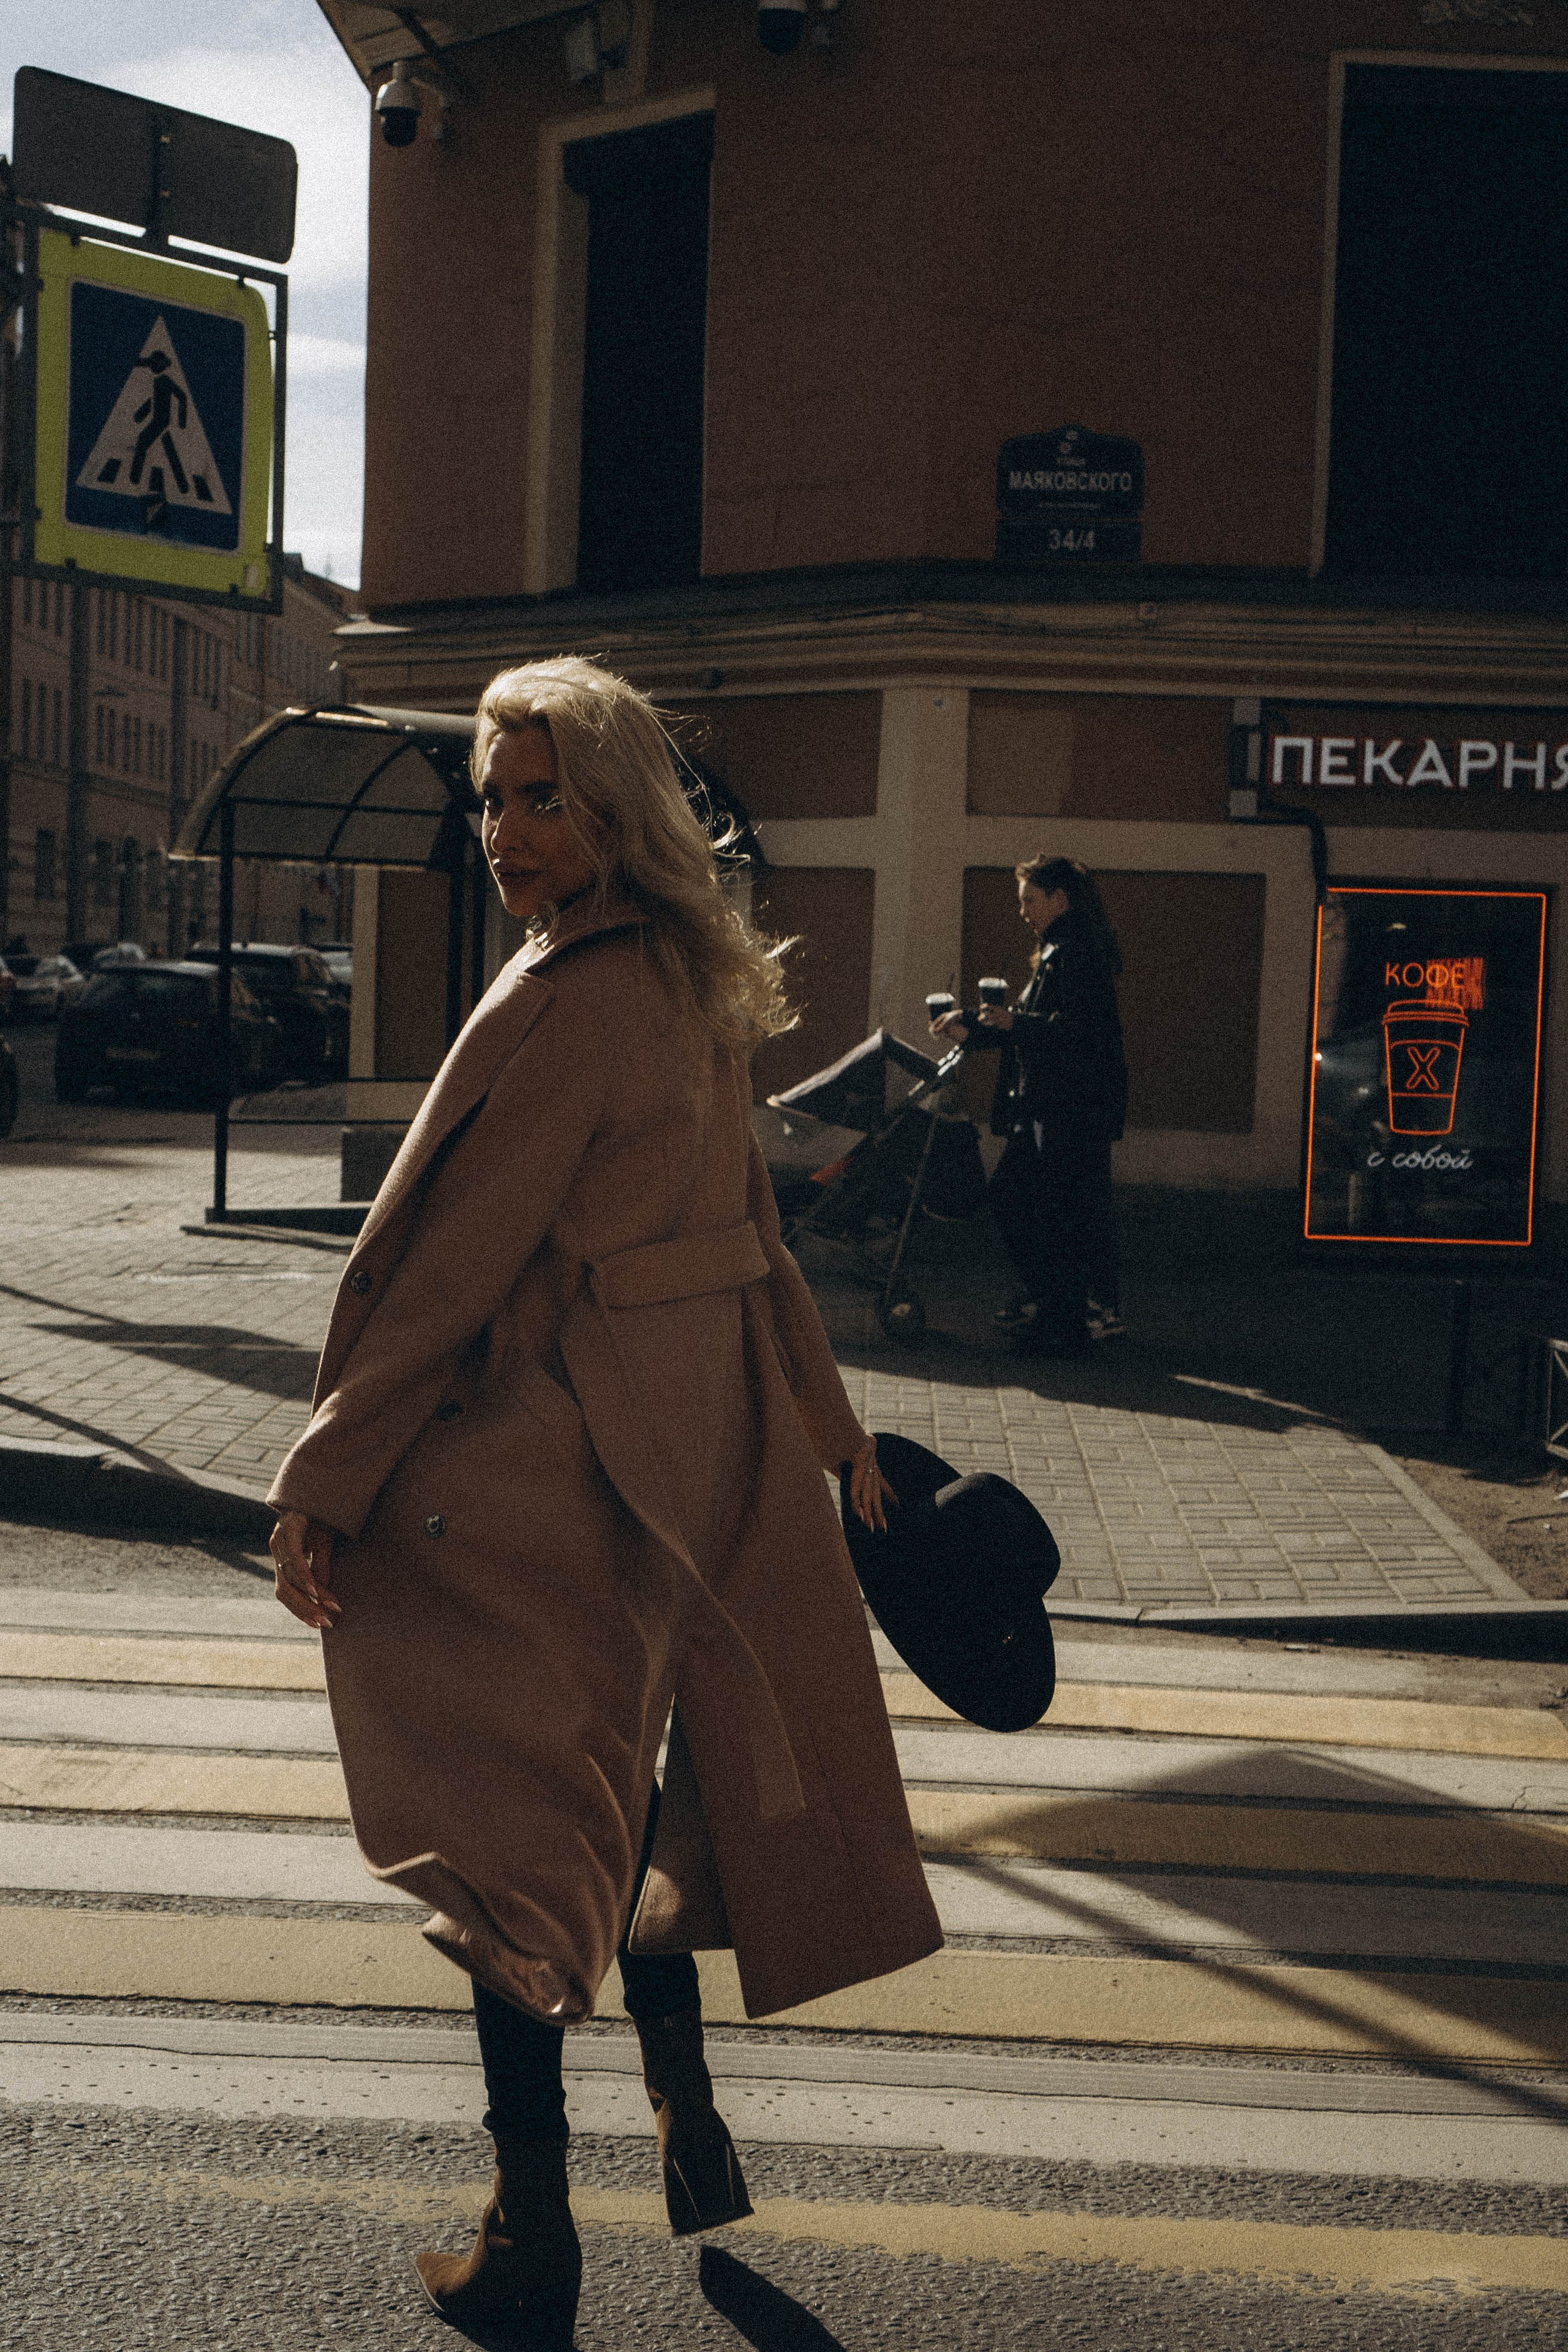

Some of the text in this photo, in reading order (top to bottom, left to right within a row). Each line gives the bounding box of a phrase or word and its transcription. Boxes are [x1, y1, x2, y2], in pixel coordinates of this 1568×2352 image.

[1009, 470, 1133, 491] МАЯКОВСКОГО
[1048, 529, 1095, 551] 34/4
[1385, 961, 1466, 989] КОФЕ
[1366, 1143, 1474, 1170] с собой
